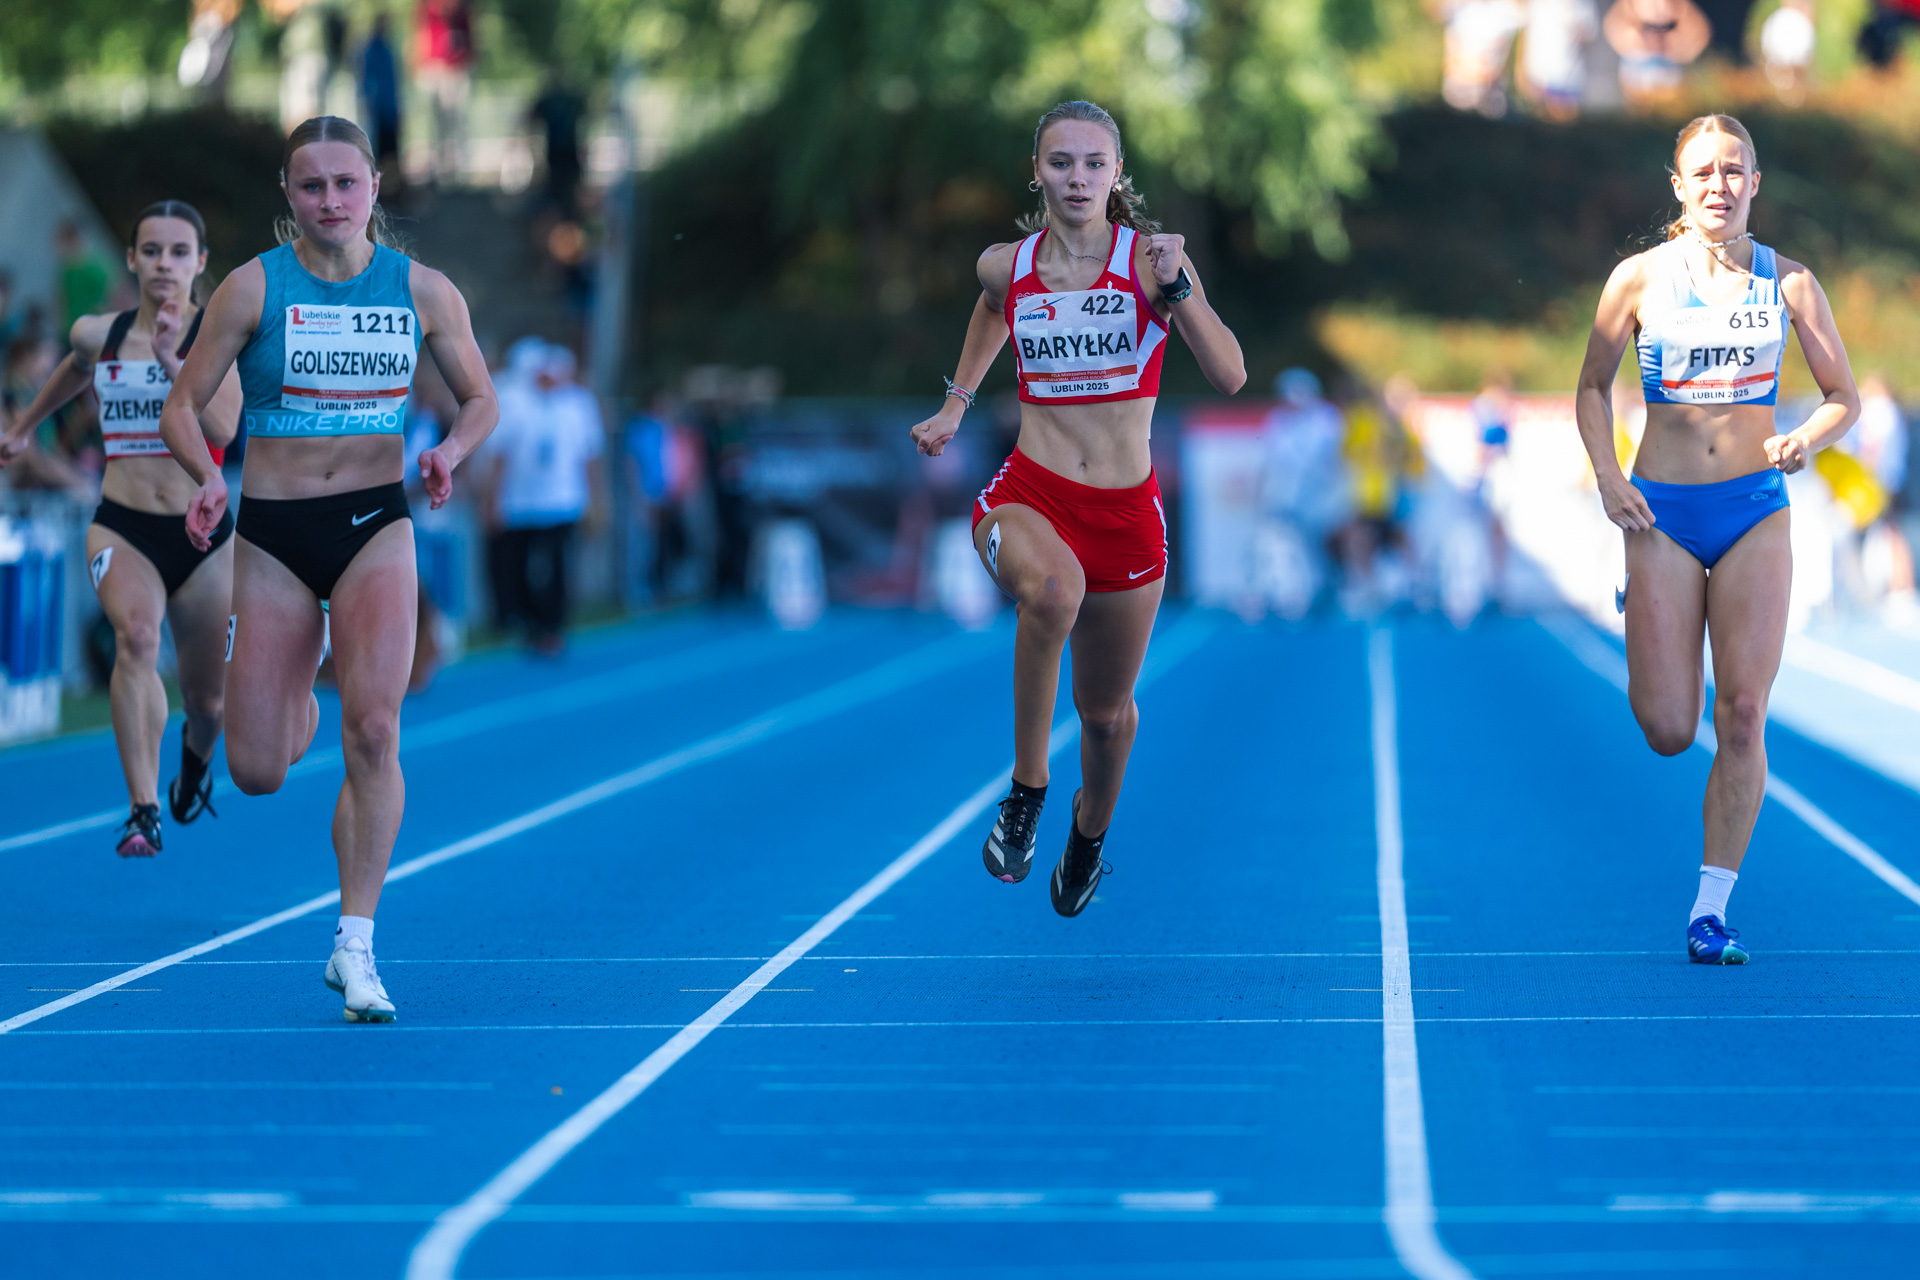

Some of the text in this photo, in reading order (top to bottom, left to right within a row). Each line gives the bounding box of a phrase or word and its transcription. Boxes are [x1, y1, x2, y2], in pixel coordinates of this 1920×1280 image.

[1081, 294, 1125, 316] 422
[302, 310, 341, 320] lubelskie
[352, 313, 411, 336] 1211
[1018, 311, 1047, 323] polanik
[1729, 311, 1769, 329] 615
[1021, 332, 1132, 360] BARYŁKA
[291, 350, 409, 376] GOLISZEWSKA
[1690, 346, 1755, 368] FITAS
[146, 365, 173, 384] 53
[1051, 381, 1110, 393] LUBLIN 2025
[1692, 388, 1749, 399] LUBLIN 2025
[104, 399, 163, 421] ZIEMB
[315, 400, 377, 411] LUBLIN 2025
[266, 414, 333, 432] NIKE
[341, 412, 398, 430] PRO
